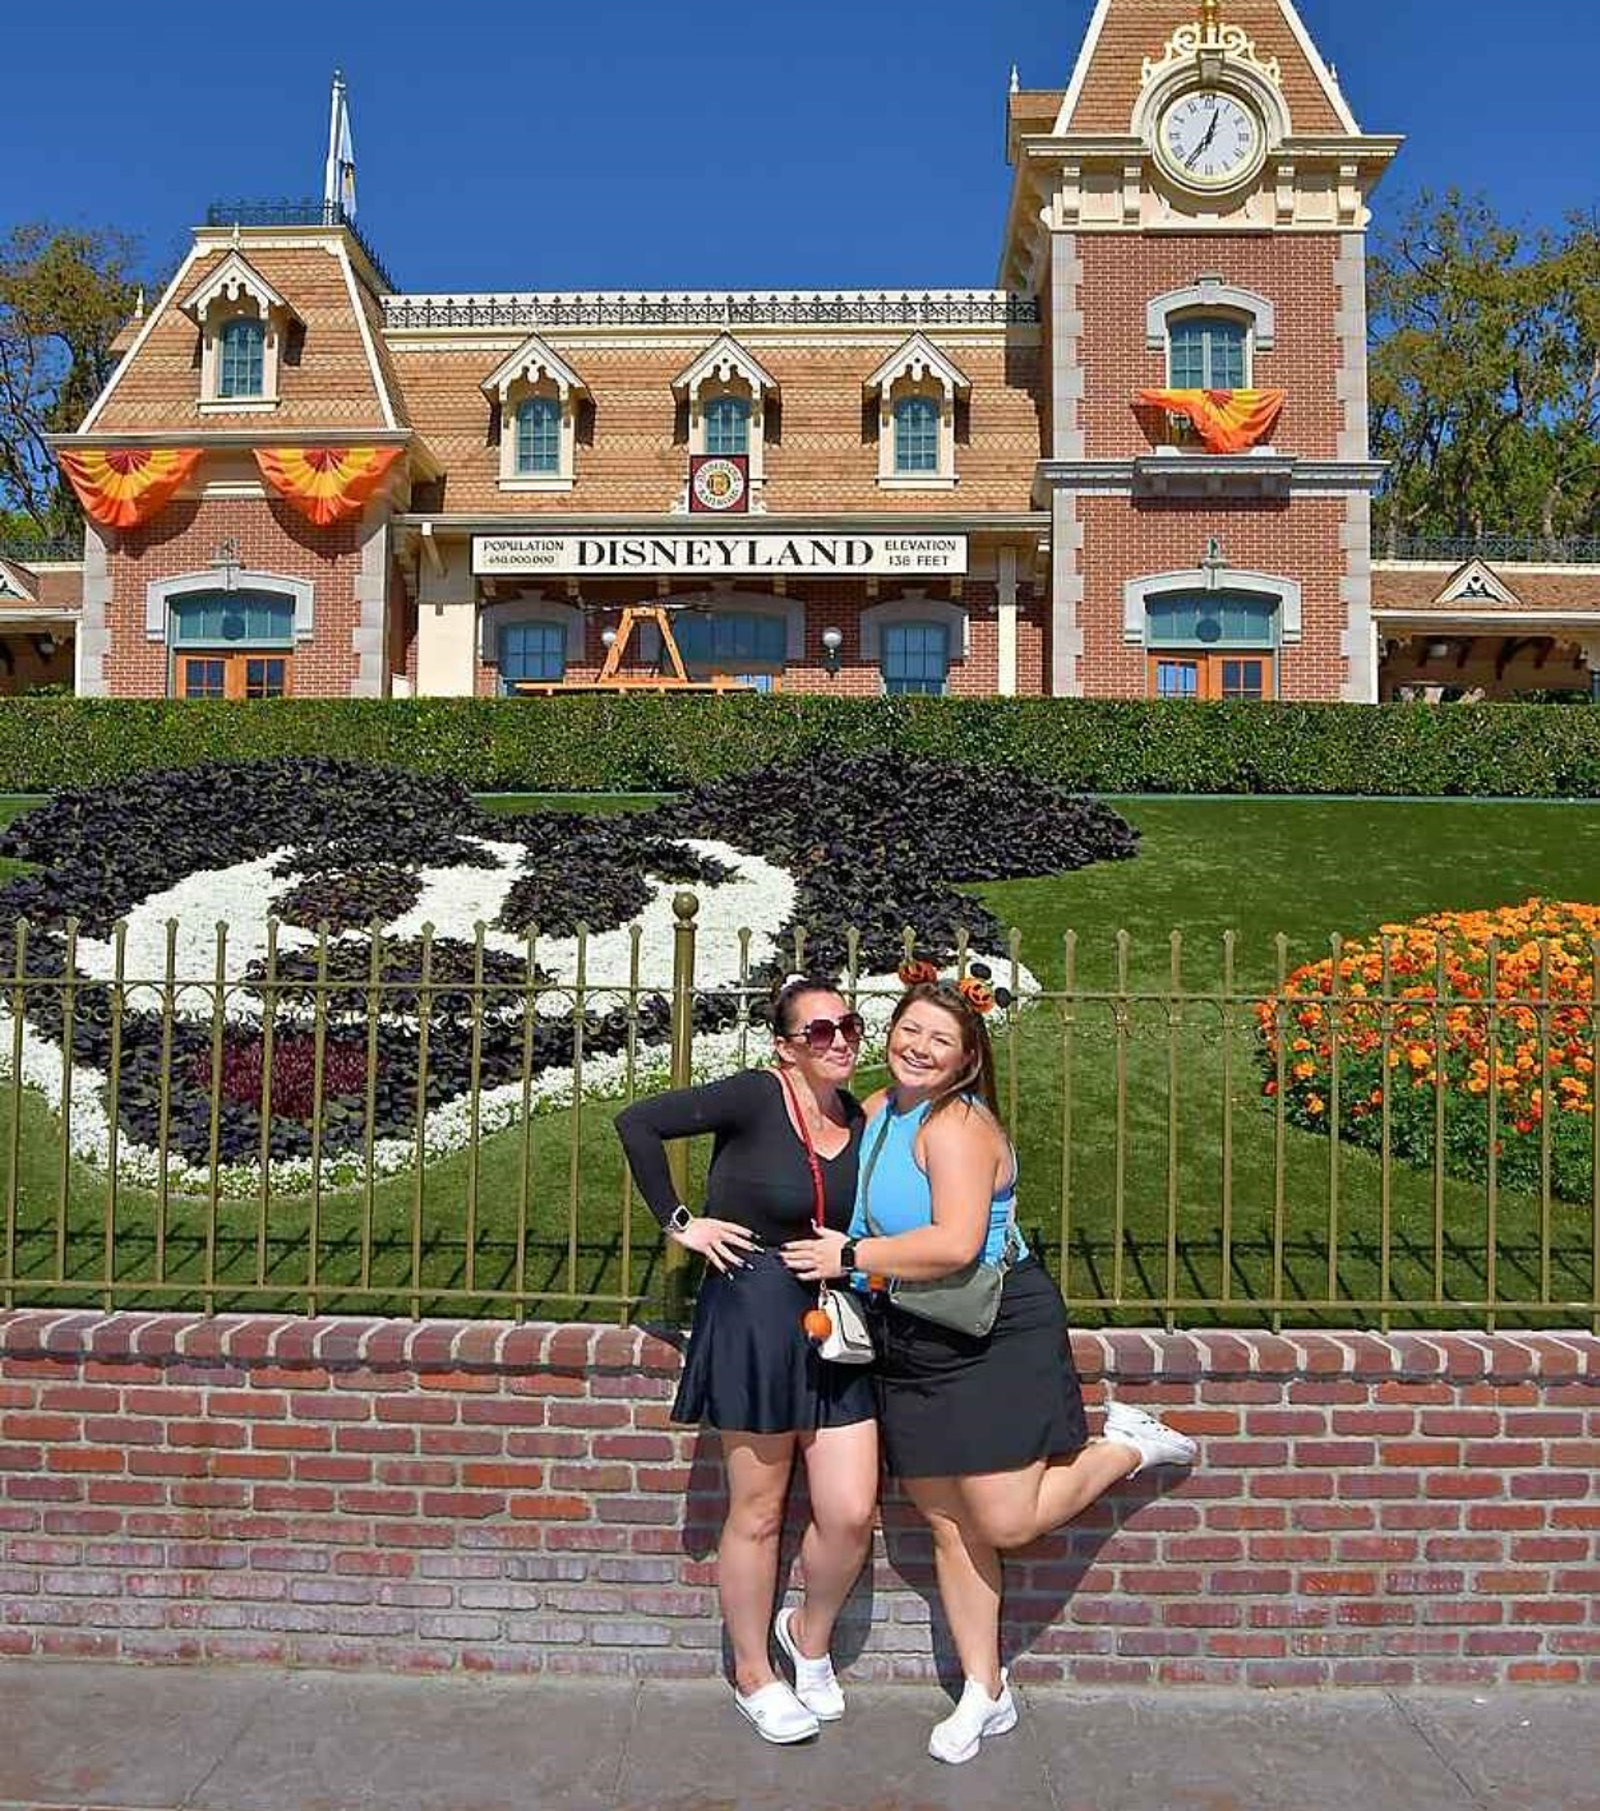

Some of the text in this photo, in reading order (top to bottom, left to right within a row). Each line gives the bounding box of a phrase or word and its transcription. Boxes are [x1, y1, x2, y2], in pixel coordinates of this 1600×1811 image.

[483, 540, 564, 551] POPULATION
[885, 540, 956, 551] ELEVATION
[576, 540, 874, 566] DISNEYLAND
[917, 555, 949, 566] FEET
